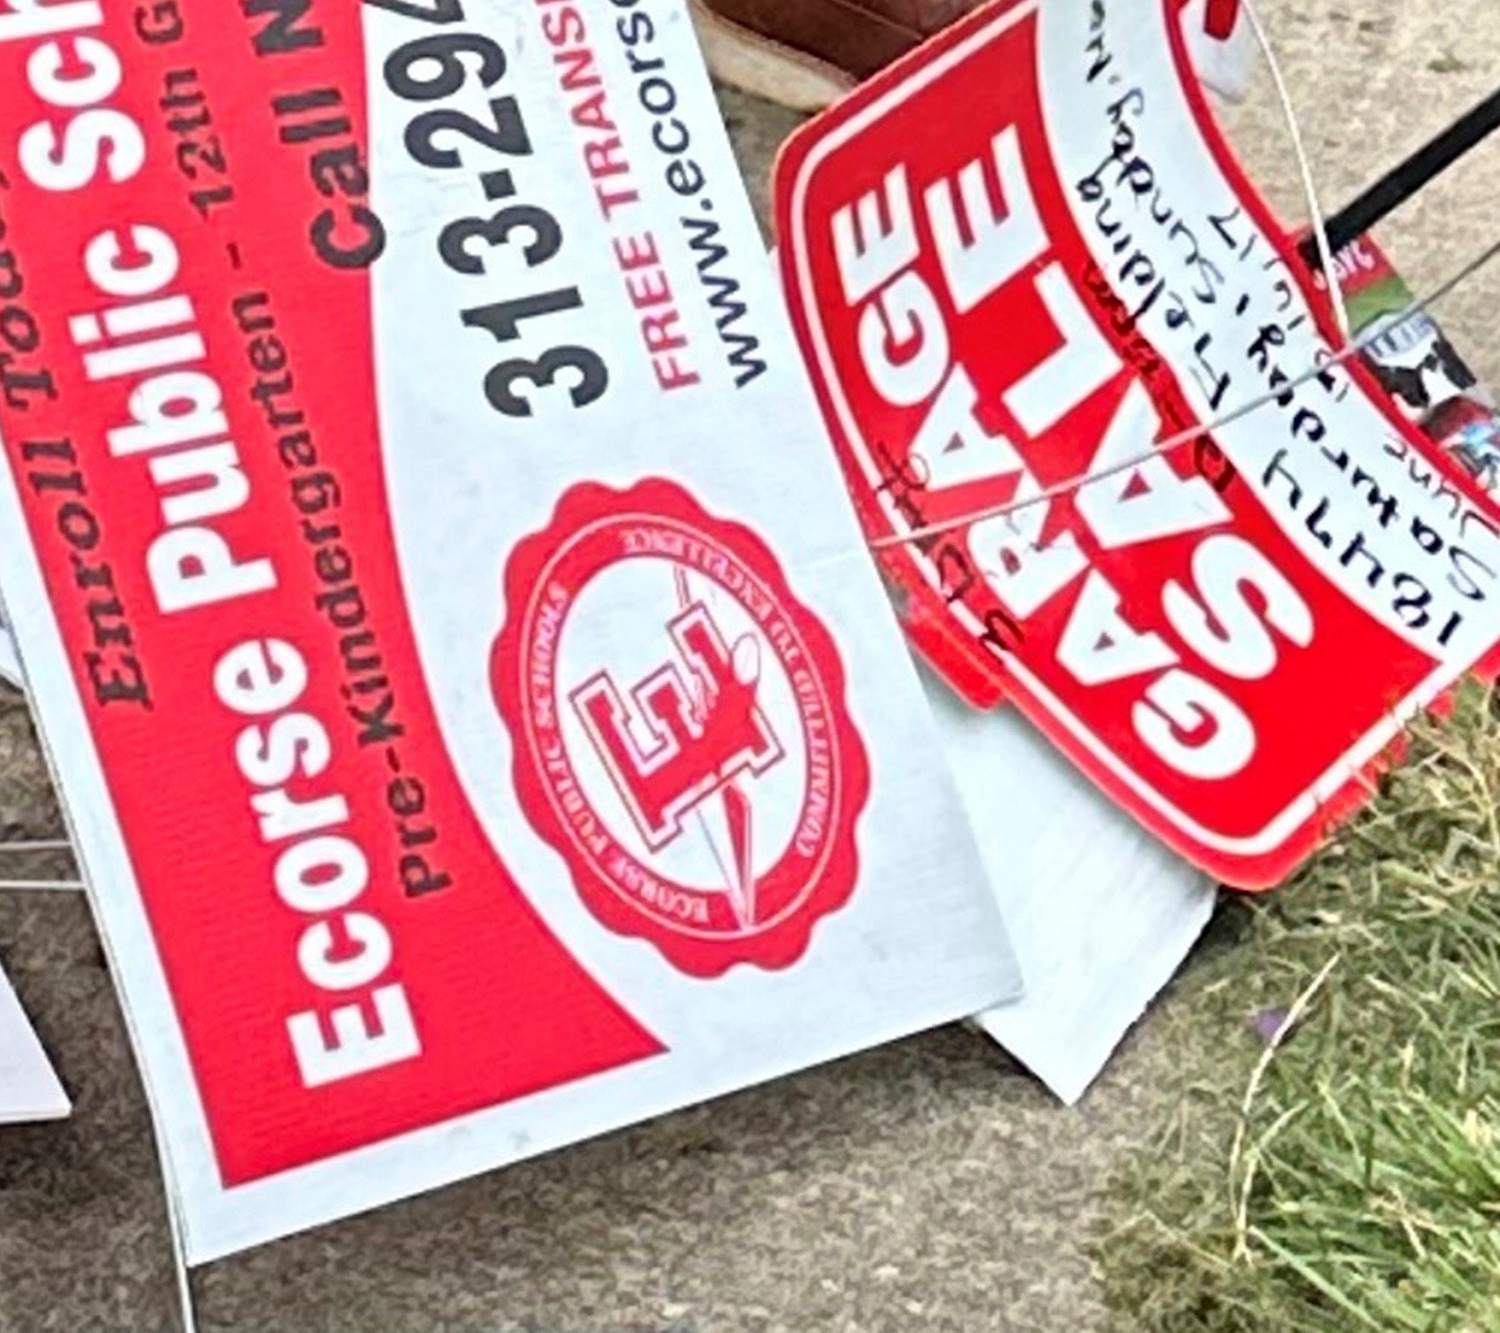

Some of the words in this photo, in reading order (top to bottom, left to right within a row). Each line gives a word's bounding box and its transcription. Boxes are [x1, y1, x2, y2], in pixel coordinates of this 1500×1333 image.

[159, 68, 234, 217] 12th
[270, 87, 387, 271] Call
[68, 221, 278, 614] Public
[614, 231, 701, 393] FREE
[924, 123, 1316, 681] SALE
[1076, 171, 1228, 412] Fielding
[21, 433, 152, 712] Enroll
[232, 291, 452, 898] Pre-Kindergarten
[831, 163, 1258, 780] GARAGE
[1259, 446, 1461, 649] 18474
[530, 582, 570, 728] SCHOOLS
[213, 637, 424, 1089] Ecorse
